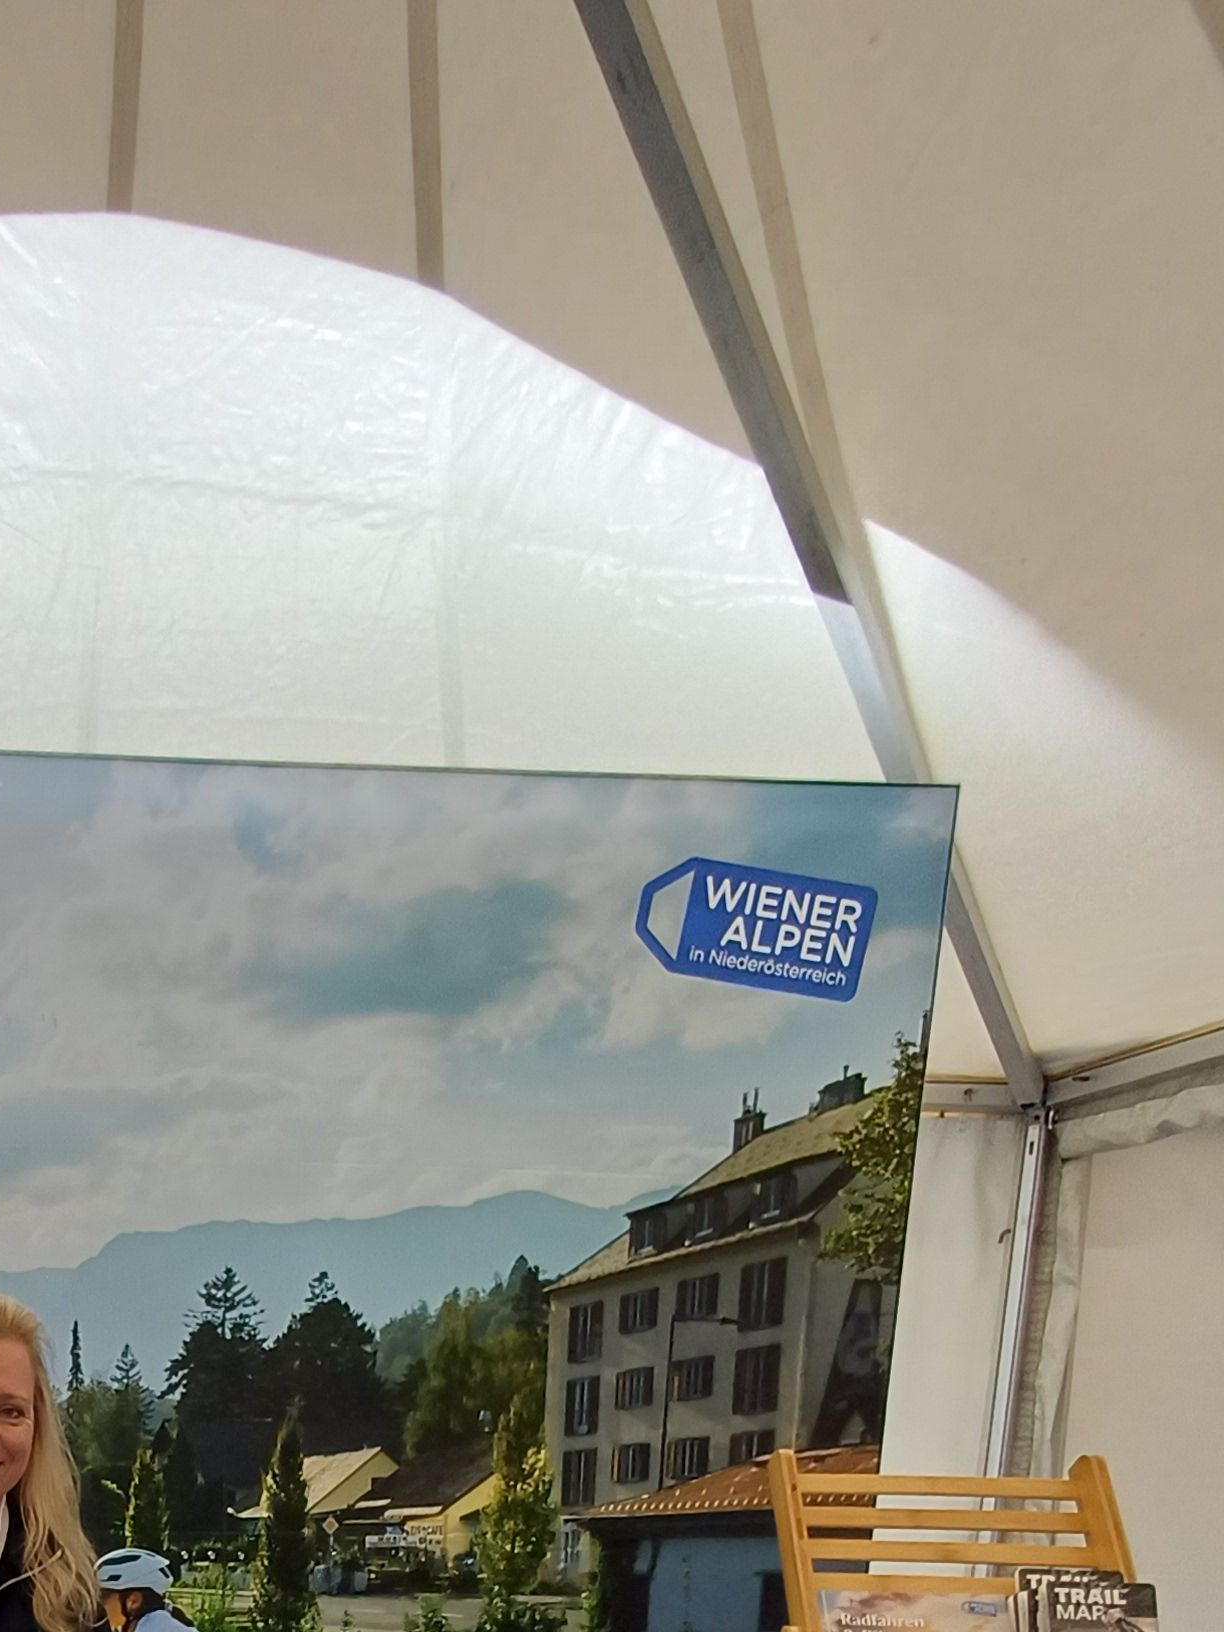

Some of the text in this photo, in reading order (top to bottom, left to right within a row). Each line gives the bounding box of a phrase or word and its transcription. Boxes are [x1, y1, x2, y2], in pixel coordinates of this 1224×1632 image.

[706, 875, 863, 934] WIENER
[719, 916, 856, 968] ALPEN
[688, 945, 847, 987] in Niederösterreich
[1054, 1588, 1127, 1605] TRAIL
[840, 1613, 925, 1628] Radfahren
[1056, 1604, 1104, 1621] MAP
